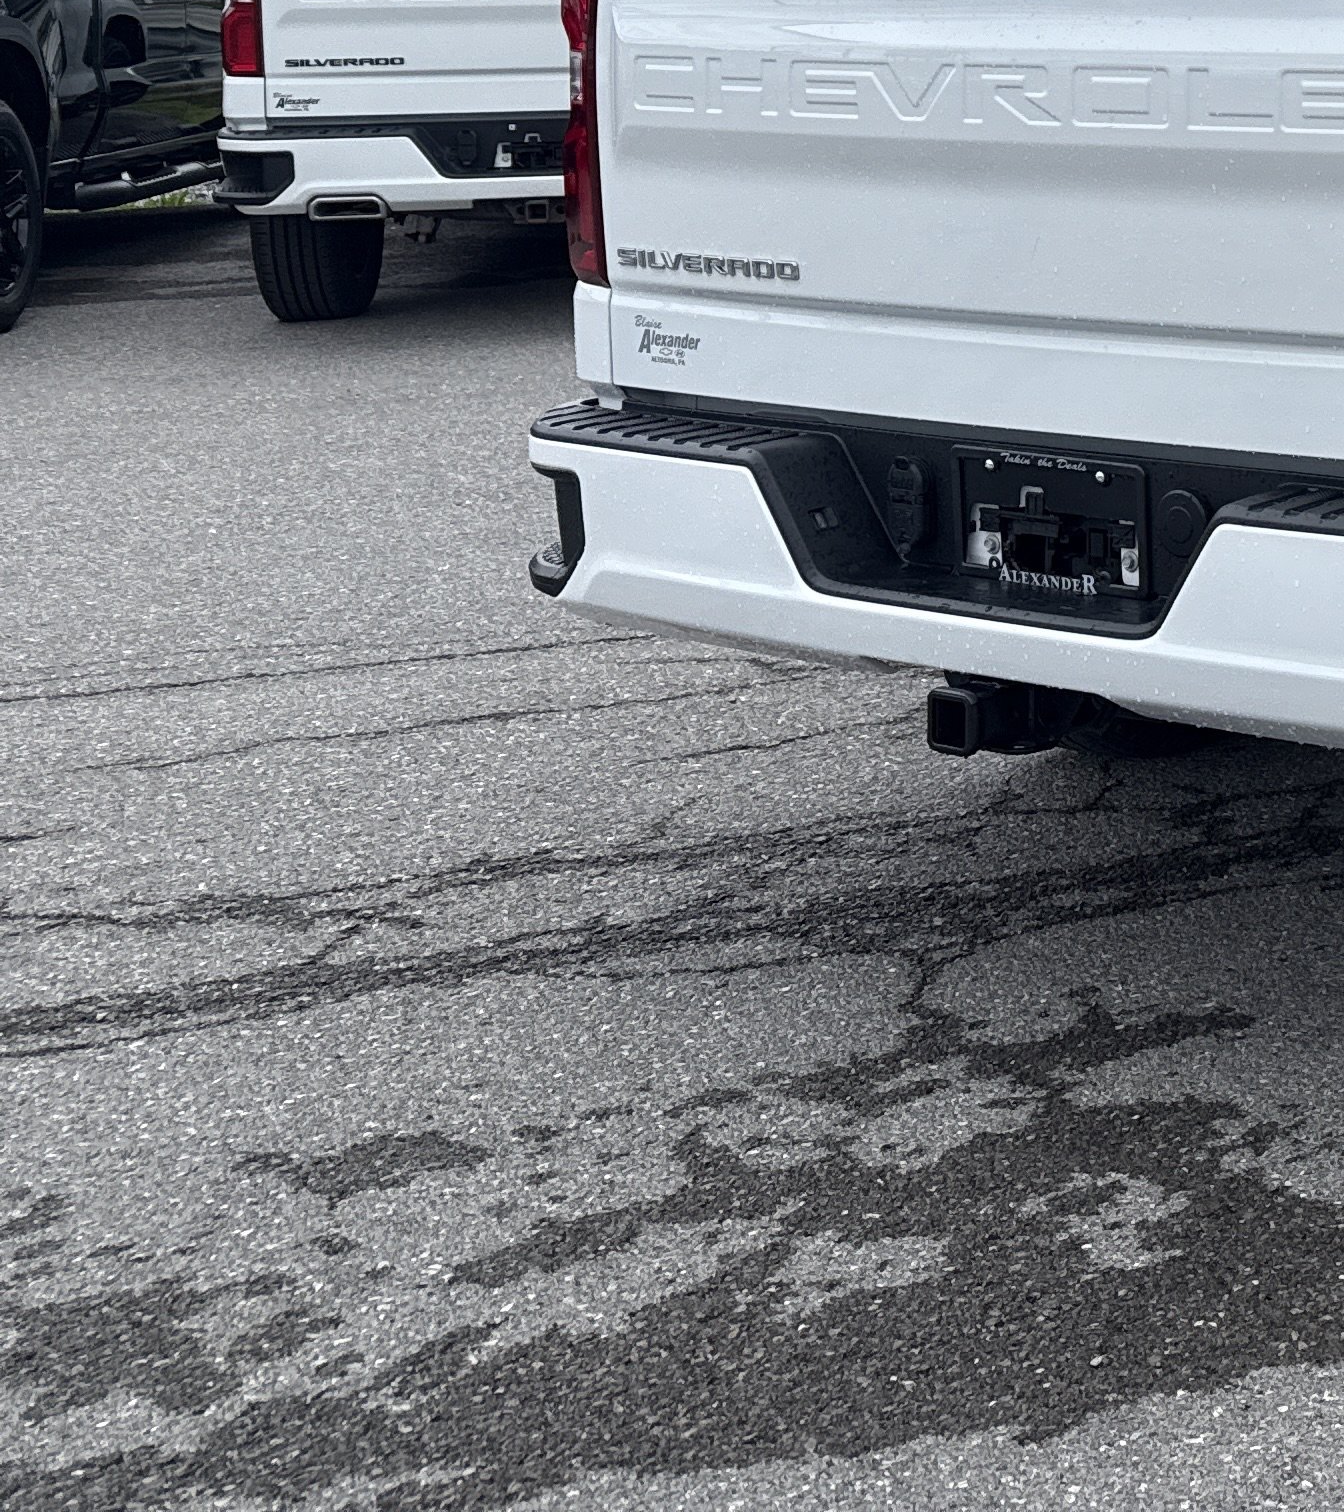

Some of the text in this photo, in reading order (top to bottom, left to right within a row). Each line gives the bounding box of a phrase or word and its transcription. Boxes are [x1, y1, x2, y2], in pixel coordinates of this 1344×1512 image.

[284, 57, 404, 67] SILVERADO
[616, 248, 800, 280] SILVERADO
[634, 314, 663, 330] Blaise
[638, 328, 701, 354] Alexander
[1038, 457, 1053, 468] the
[1056, 459, 1088, 472] Deals
[999, 563, 1097, 596] ALEXANDER
